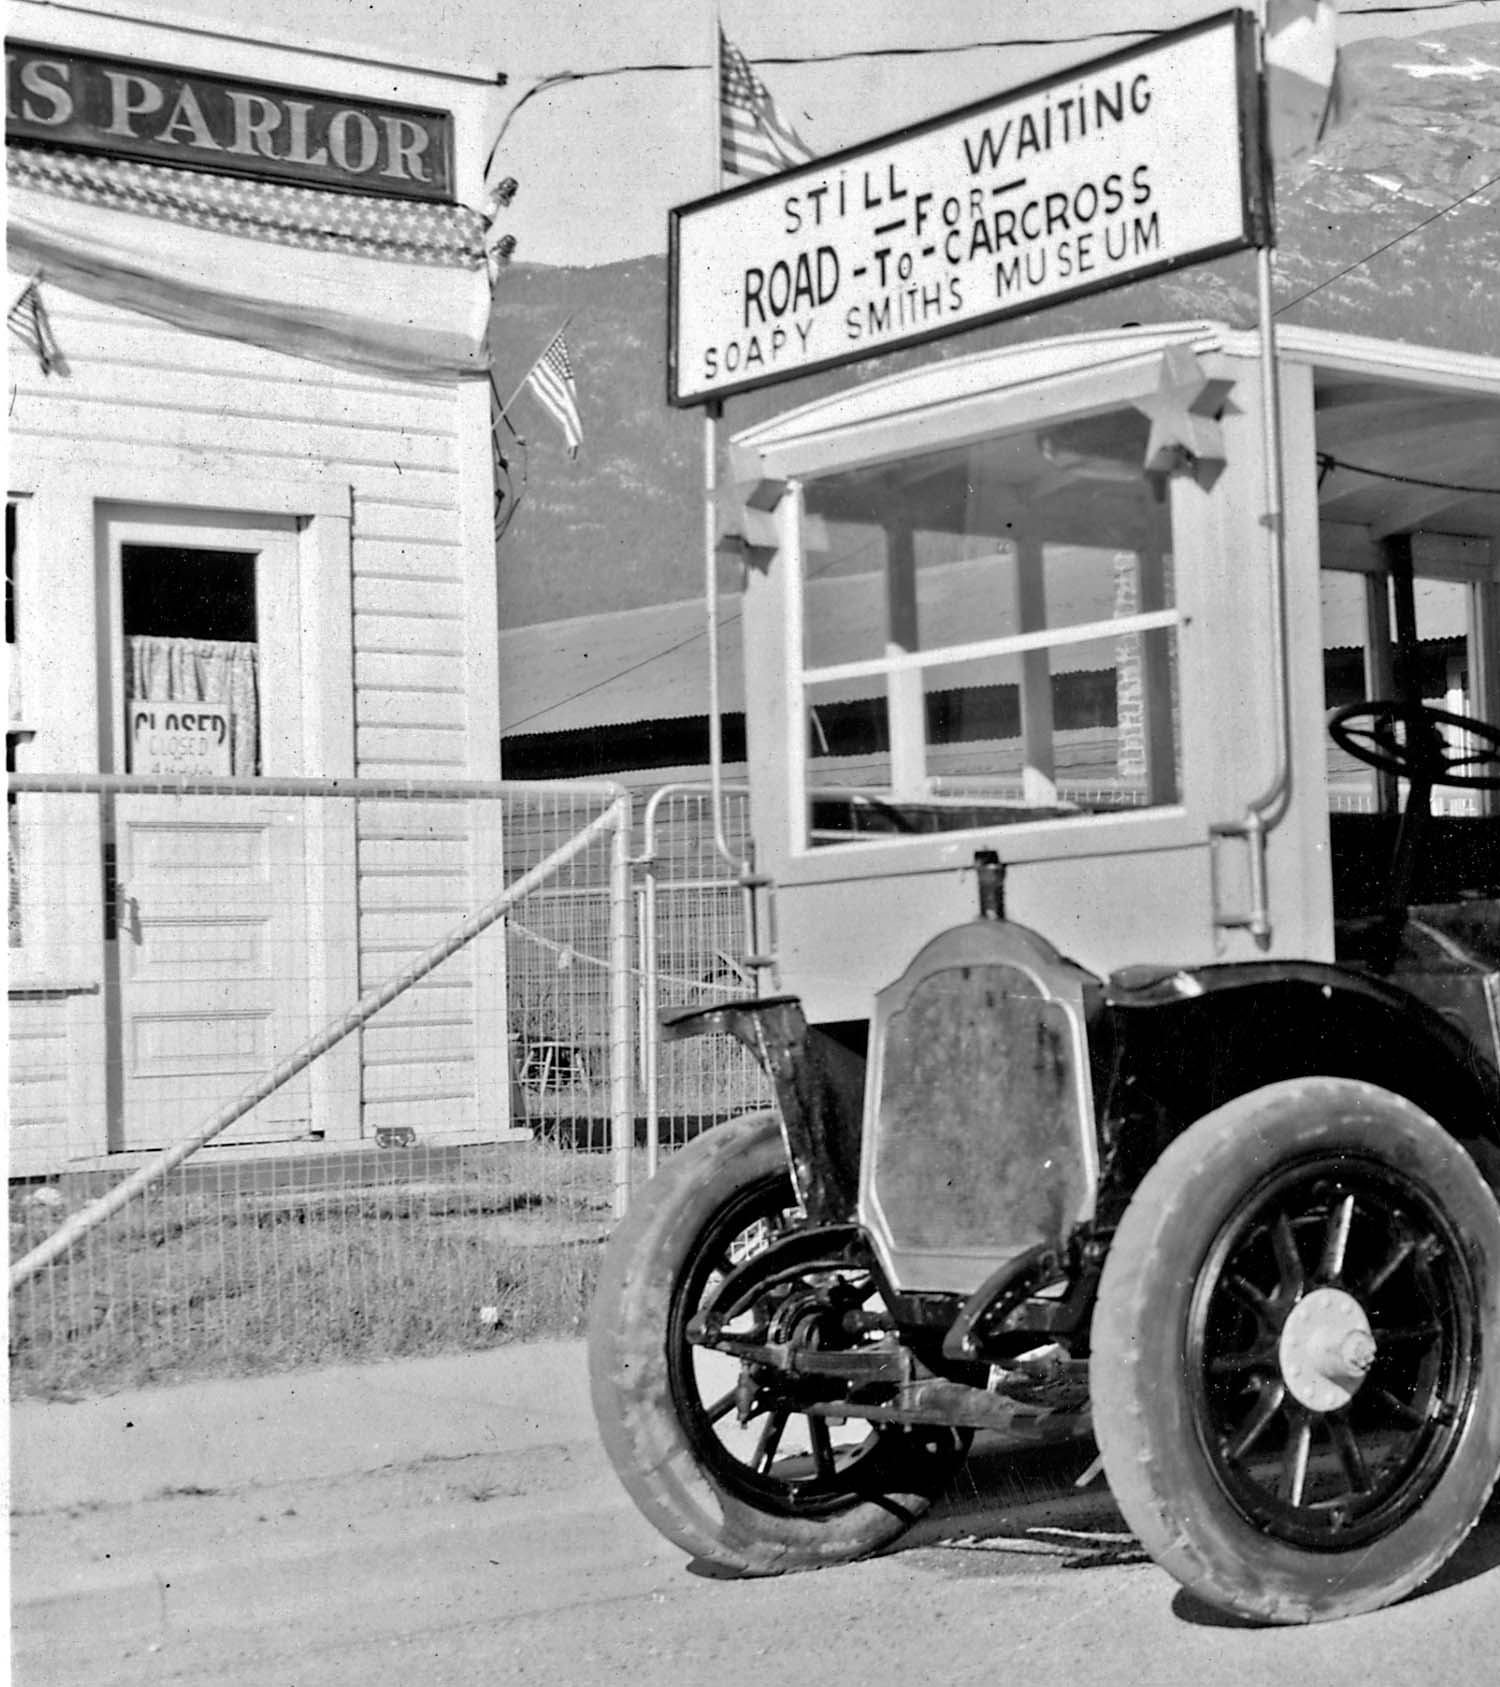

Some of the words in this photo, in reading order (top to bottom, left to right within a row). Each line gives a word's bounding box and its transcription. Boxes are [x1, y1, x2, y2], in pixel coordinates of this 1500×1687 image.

[102, 70, 433, 183] PARLOR
[704, 317, 814, 380] SOAPY
[996, 211, 1161, 298] MUSEUM
[745, 245, 840, 329] ROAD
[944, 165, 1151, 266] CARCROSS
